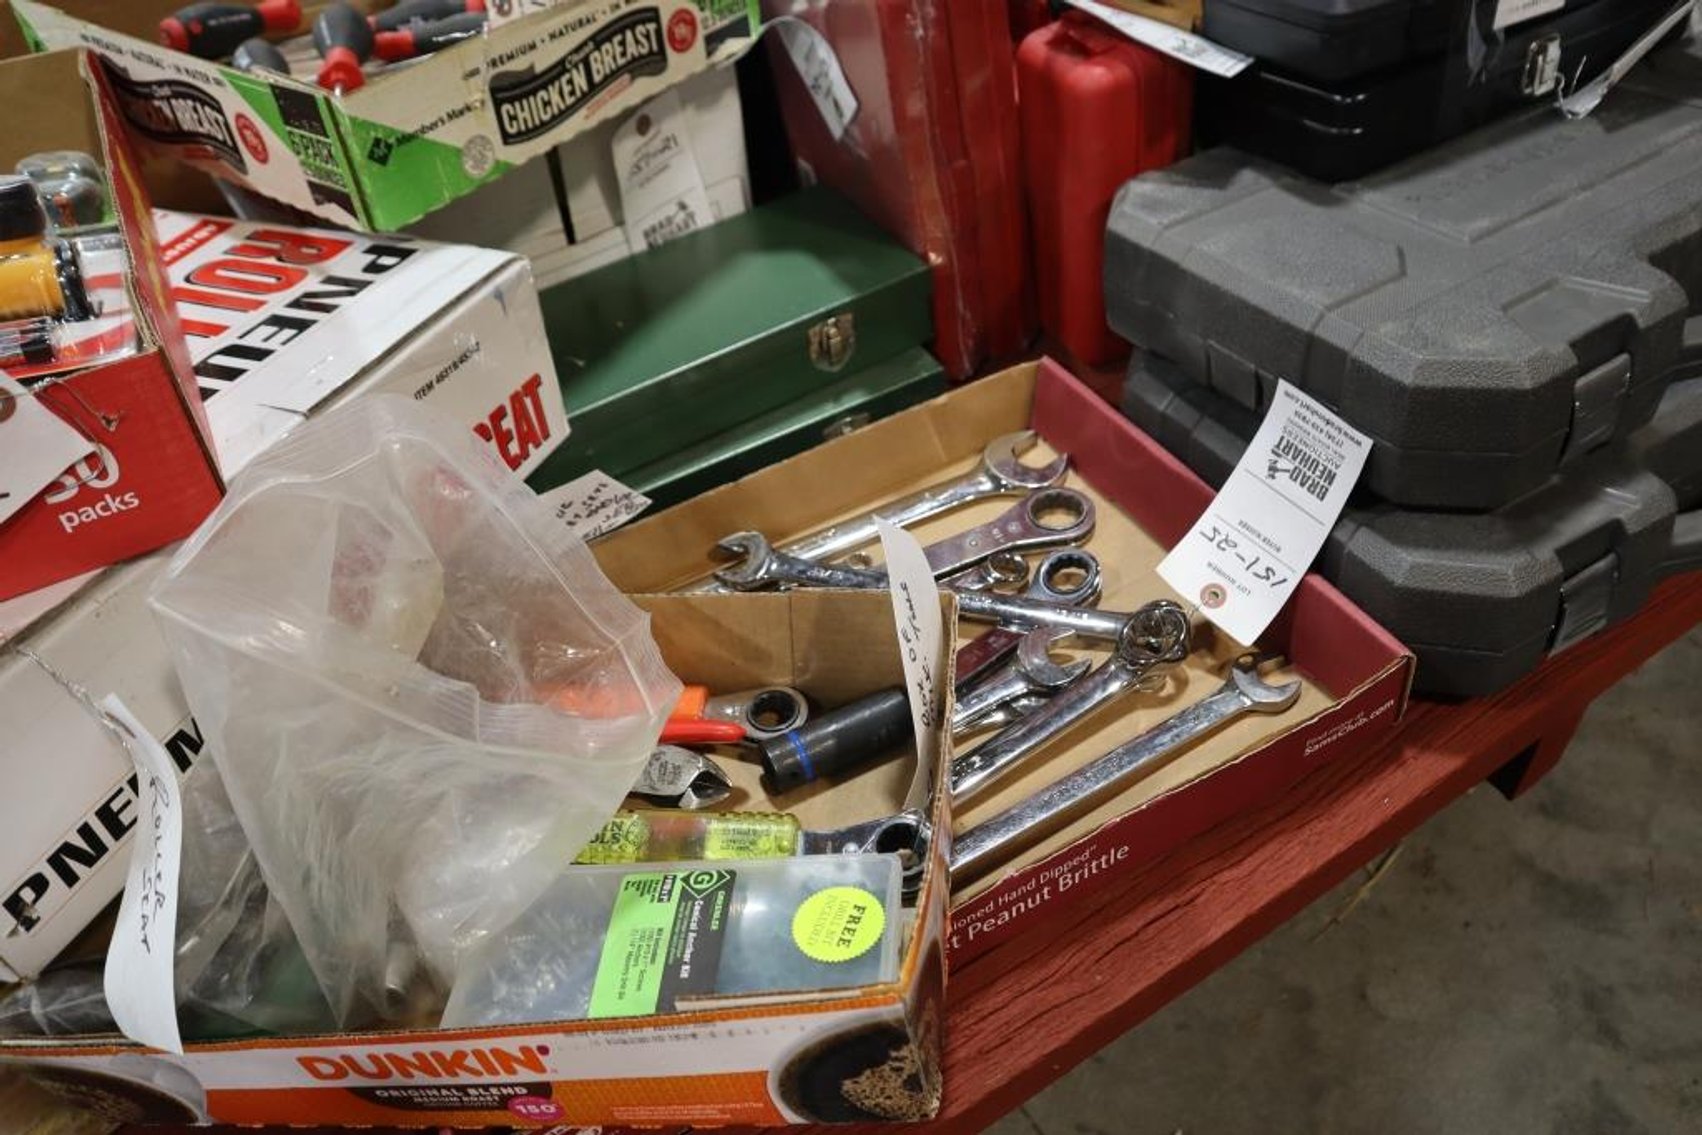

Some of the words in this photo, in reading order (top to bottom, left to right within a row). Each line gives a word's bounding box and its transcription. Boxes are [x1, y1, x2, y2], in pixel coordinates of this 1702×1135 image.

[549, 16, 598, 41] NATURAL
[500, 63, 589, 136] CHICKEN
[589, 22, 659, 84] BREAST
[414, 380, 435, 400] ITEM
[472, 372, 550, 472] EAT
[1275, 435, 1337, 486] NEUHART
[1289, 466, 1329, 502] BRAD
[58, 491, 140, 533] packs
[1199, 525, 1288, 588] 151-25
[967, 886, 1052, 941] Peanut
[1058, 846, 1130, 892] Brittle
[998, 878, 1036, 906] Hand
[837, 904, 867, 949] FREE
[375, 1088, 463, 1098] ORIGINAL
[469, 1086, 528, 1096] BLEND
